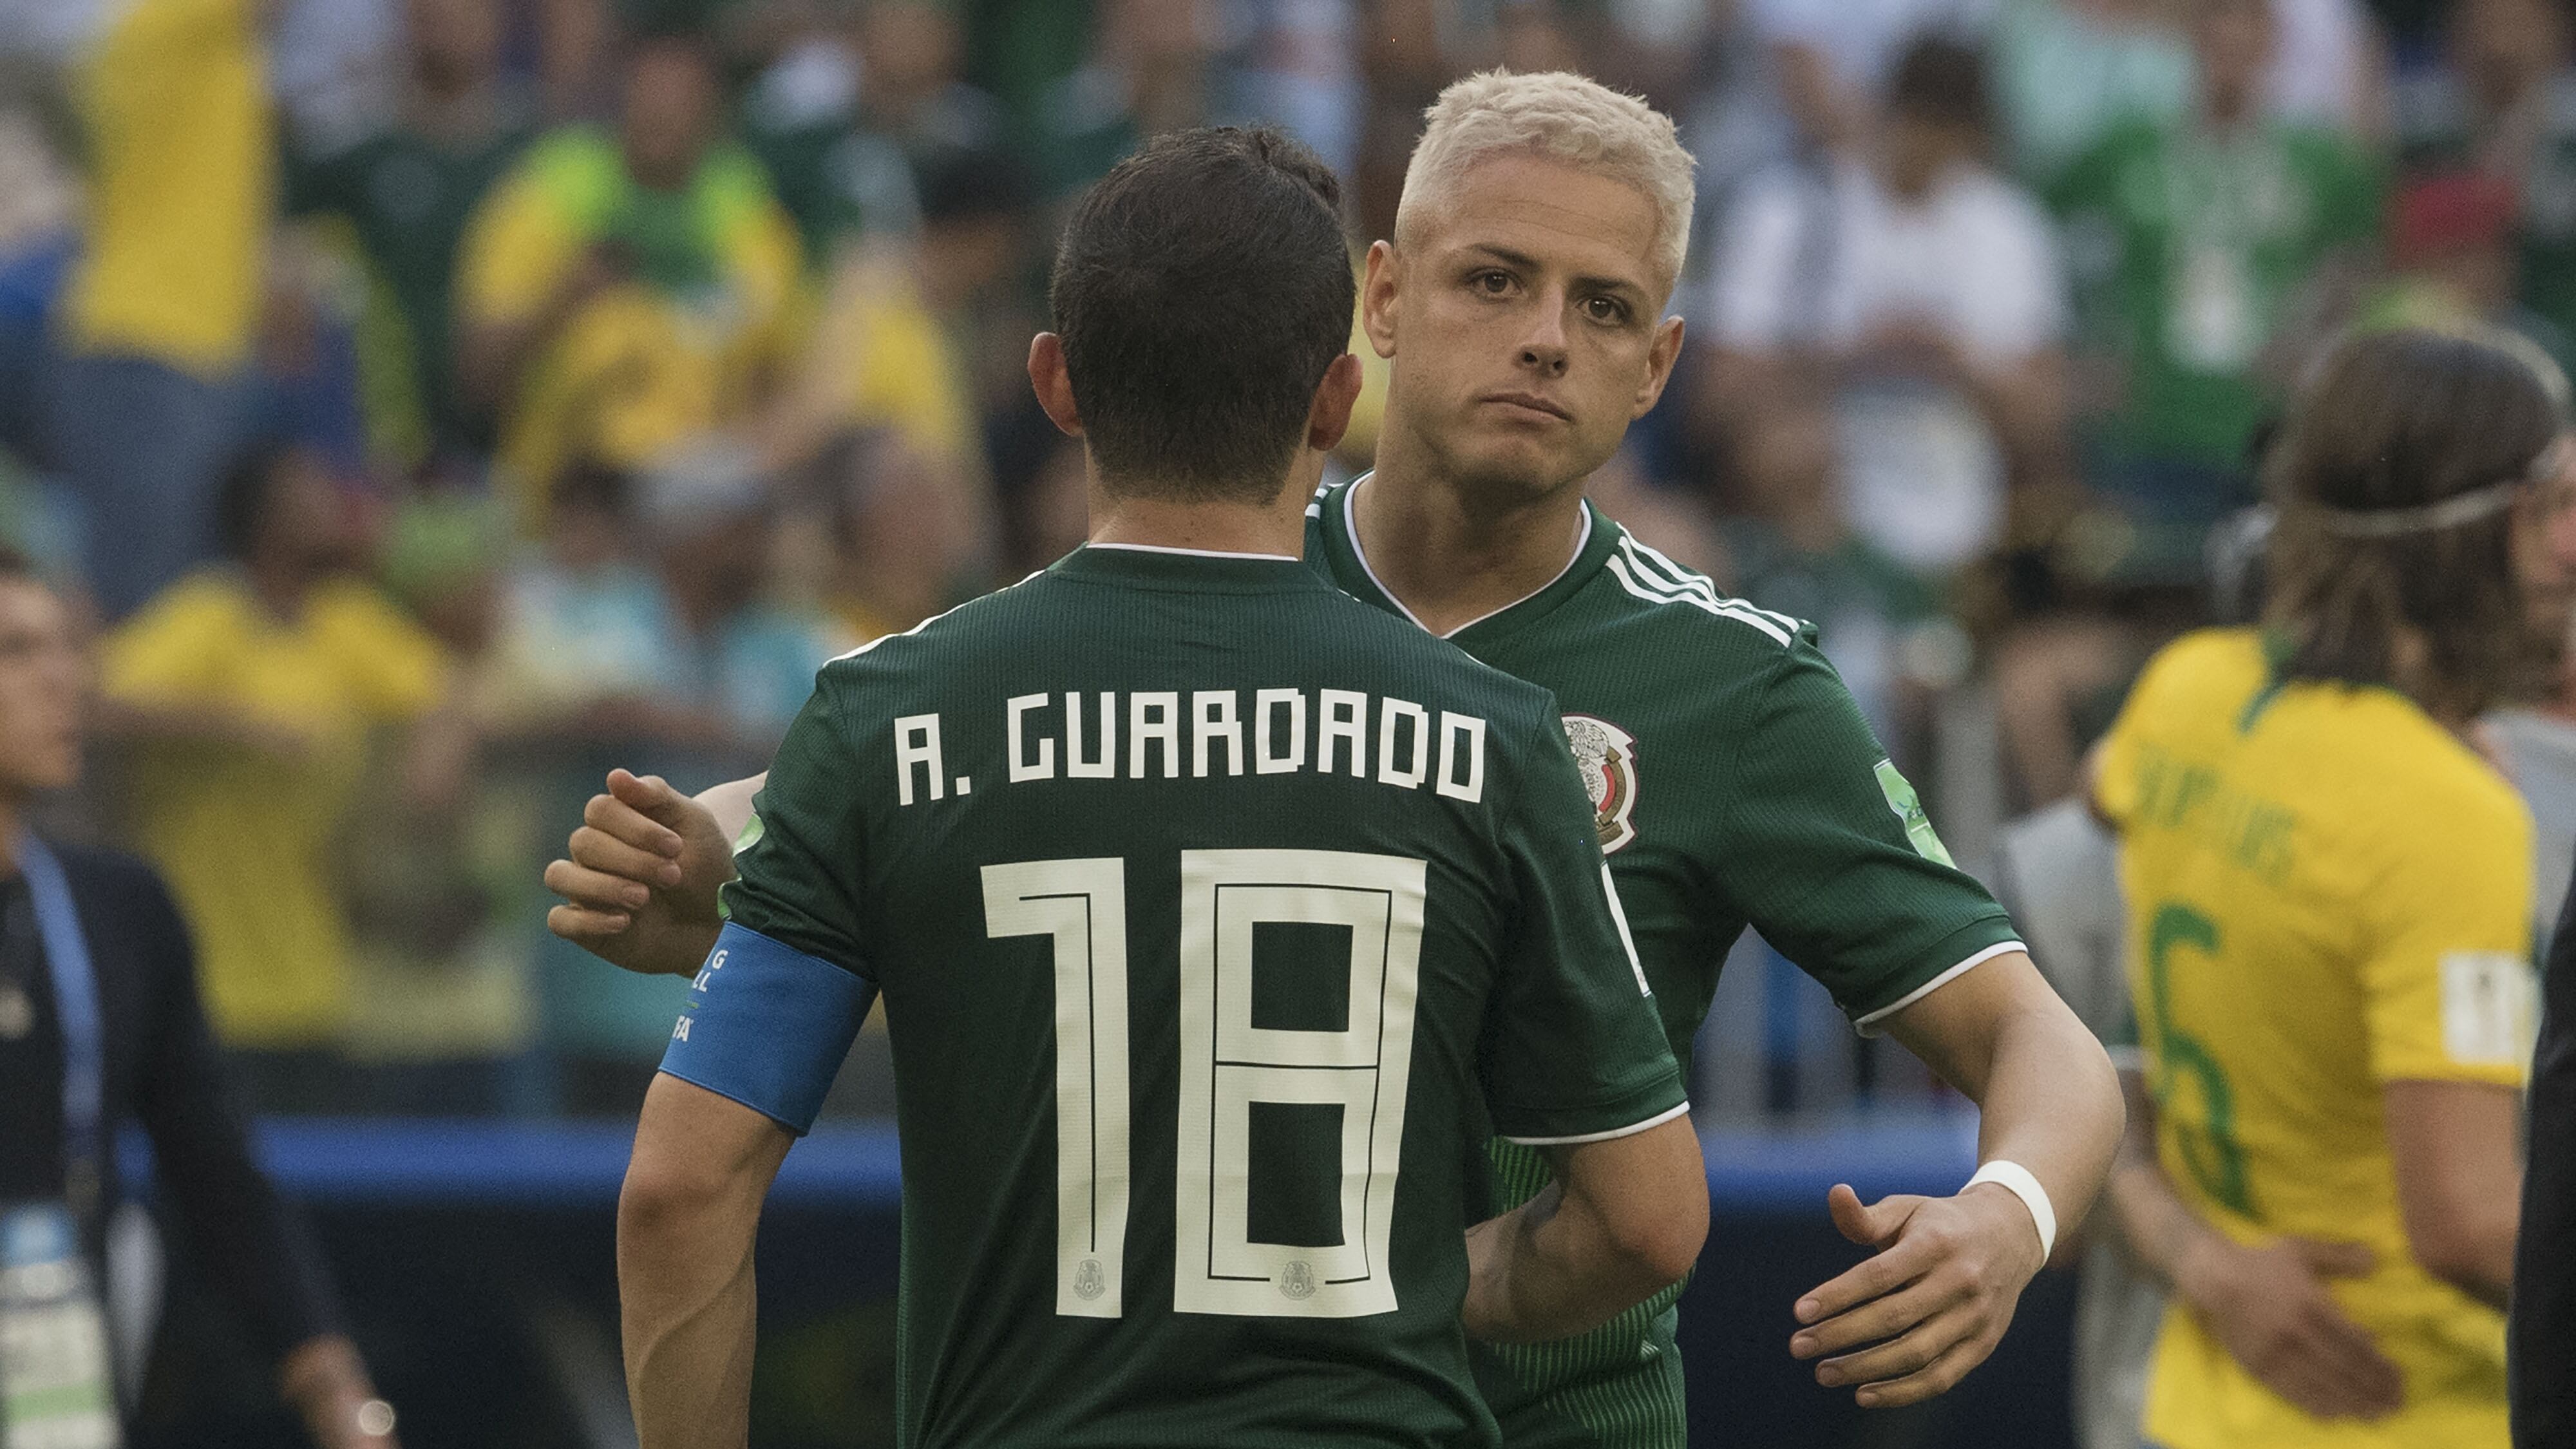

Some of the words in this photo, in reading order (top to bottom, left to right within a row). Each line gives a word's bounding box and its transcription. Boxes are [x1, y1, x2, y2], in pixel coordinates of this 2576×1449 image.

[894, 713, 971, 806] A.
[1007, 688, 1486, 804] GUARDADO
[980, 849, 1428, 1318] 18
